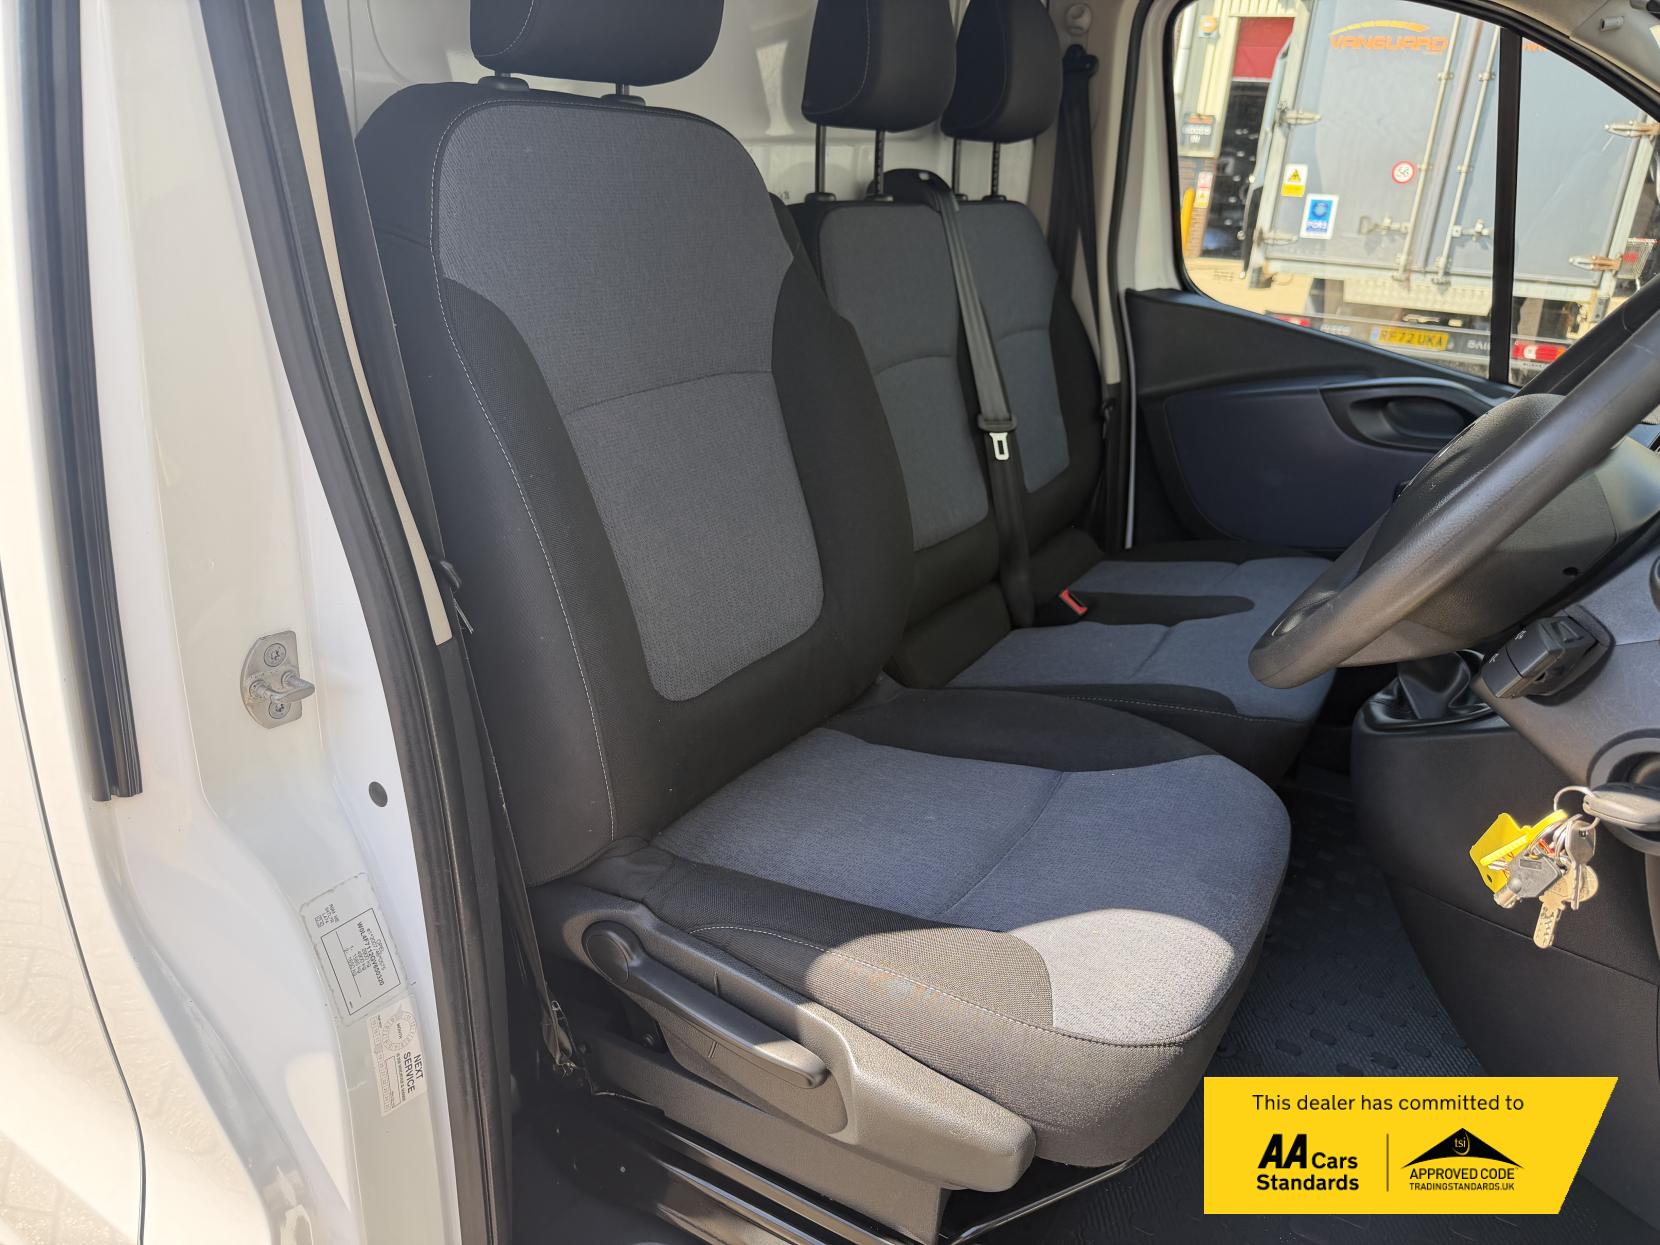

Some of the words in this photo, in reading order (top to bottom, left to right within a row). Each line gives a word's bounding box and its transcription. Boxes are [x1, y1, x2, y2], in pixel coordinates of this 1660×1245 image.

[1330, 35, 1448, 54] VANGUARD
[403, 1051, 415, 1093] SERVICE
[413, 1054, 423, 1079] NEXT
